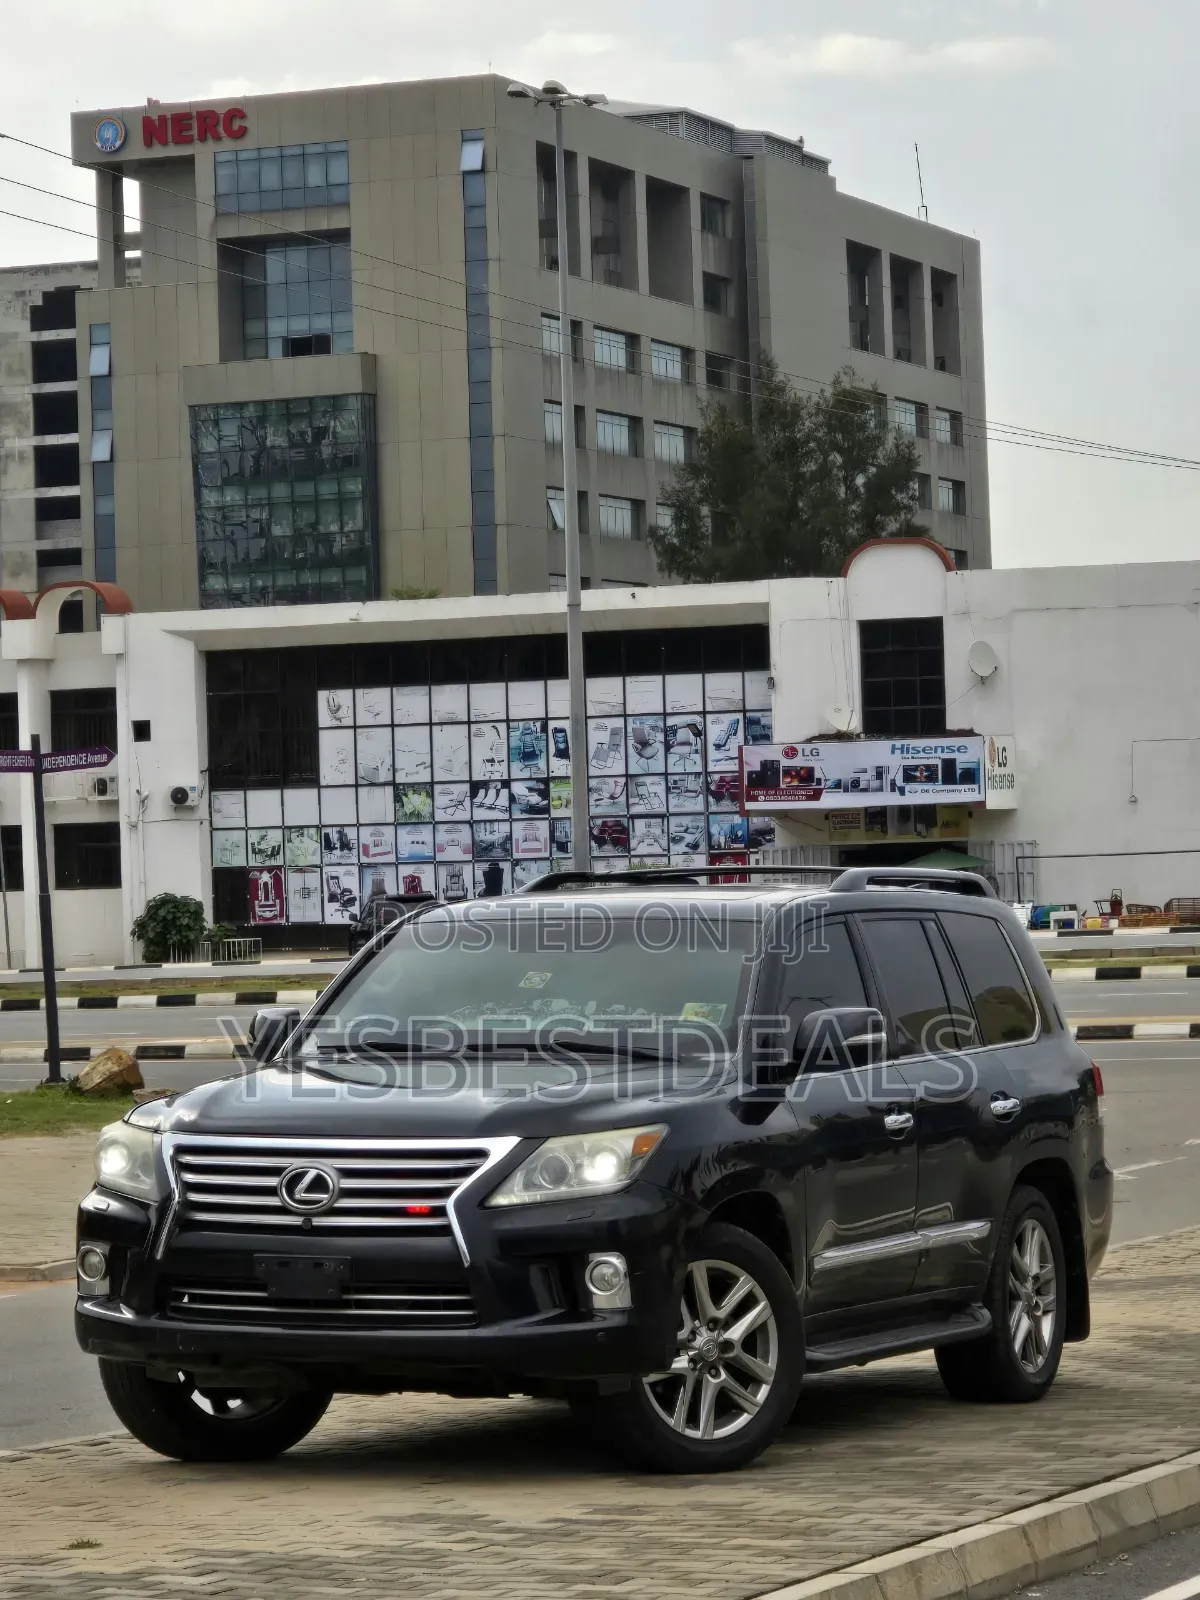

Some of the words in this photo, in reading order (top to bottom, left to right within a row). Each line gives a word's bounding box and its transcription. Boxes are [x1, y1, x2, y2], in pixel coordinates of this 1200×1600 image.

[143, 108, 247, 147] NERC
[802, 748, 820, 757] LG
[891, 744, 968, 754] Hisense
[997, 746, 1007, 767] LG
[42, 753, 87, 769] INDEPENDENCE
[87, 753, 108, 764] Avenue
[988, 768, 1015, 790] Hisense
